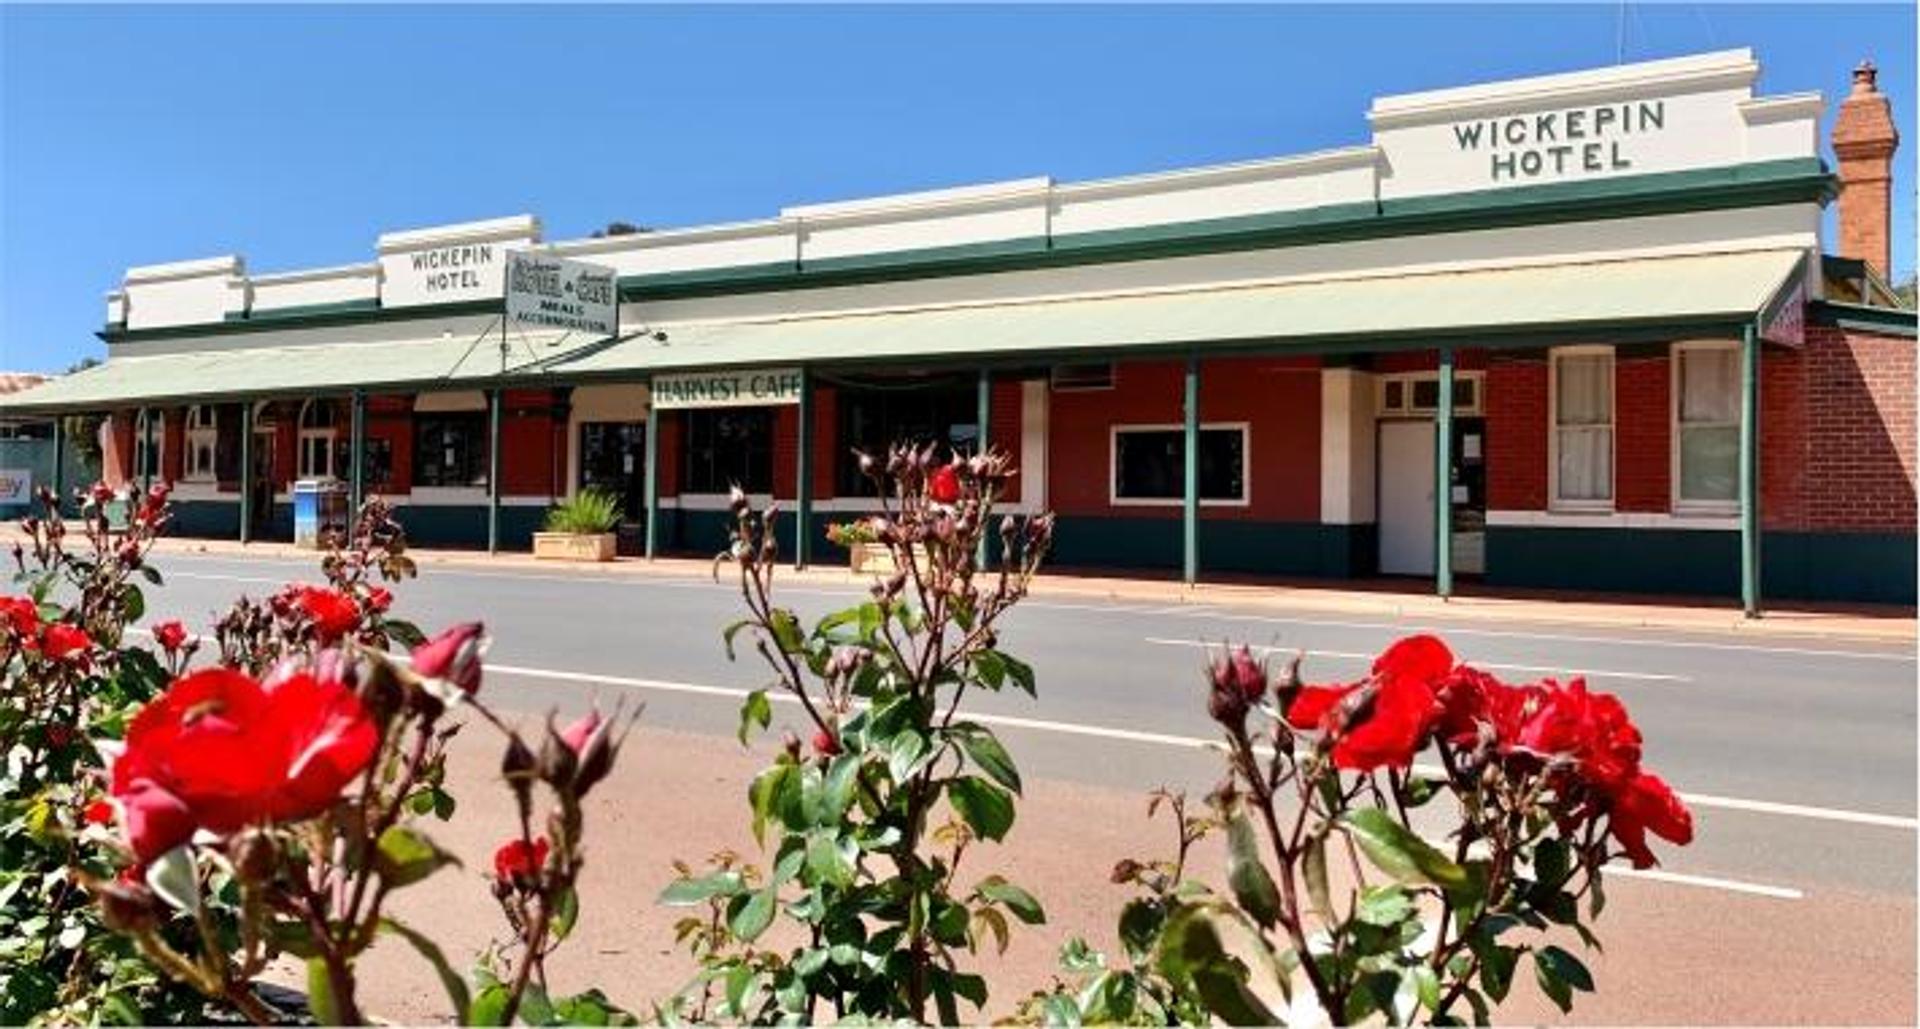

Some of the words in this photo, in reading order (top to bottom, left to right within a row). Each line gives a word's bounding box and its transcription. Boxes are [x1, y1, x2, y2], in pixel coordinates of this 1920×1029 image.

[1454, 101, 1664, 149] WICKEPIN
[1491, 141, 1631, 179] HOTEL
[411, 245, 492, 270] WICKEPIN
[427, 270, 480, 292] HOTEL
[540, 299, 585, 317] MEALS
[656, 377, 739, 402] HARVEST
